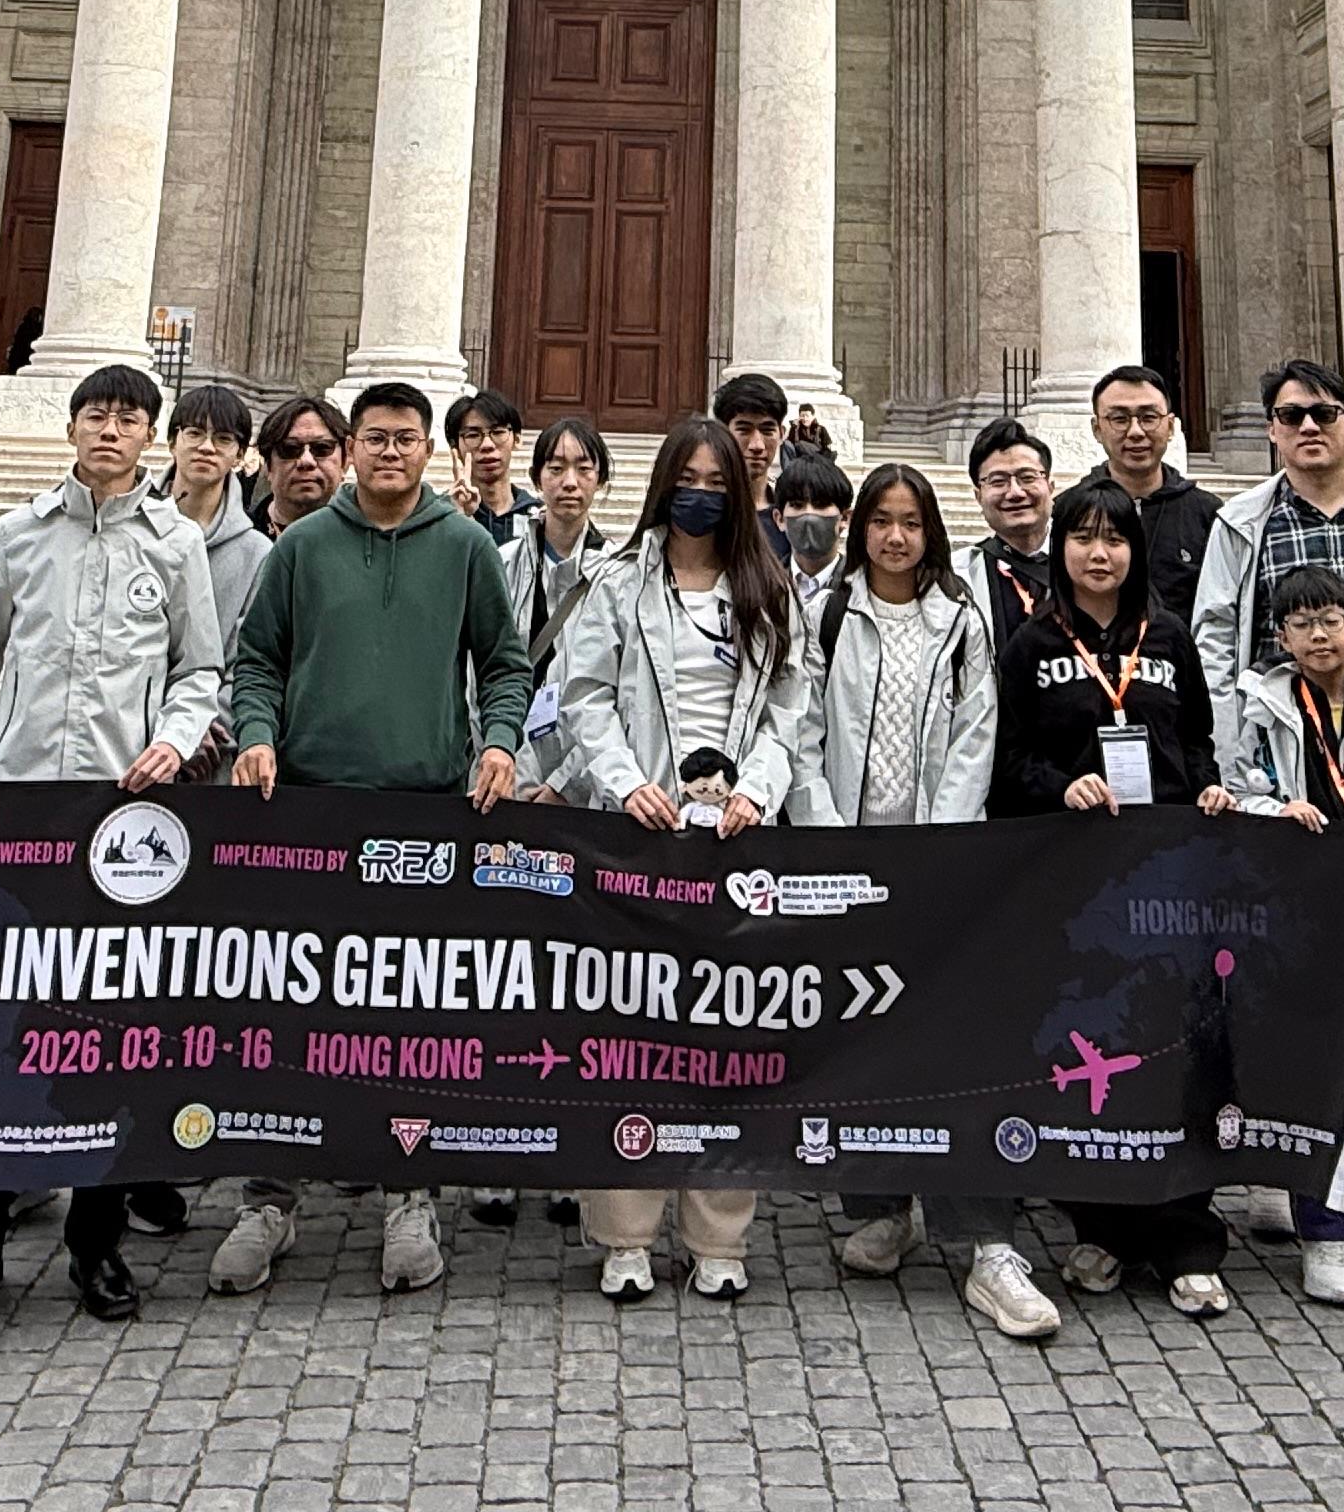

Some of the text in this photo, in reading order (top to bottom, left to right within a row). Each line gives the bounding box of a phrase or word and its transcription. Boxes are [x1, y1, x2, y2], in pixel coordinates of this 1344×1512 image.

[55, 841, 76, 864] BY
[213, 844, 348, 872] IMPLEMENTED BY
[487, 869, 560, 891] ACADEMY
[595, 869, 716, 904] TRAVEL AGENCY
[1128, 899, 1268, 936] HONG KONG
[0, 926, 823, 1030] INVENTIONS GENEVA TOUR 2026
[306, 1032, 787, 1087] HONG KONG SWITZERLAND
[622, 1124, 648, 1139] ESF
